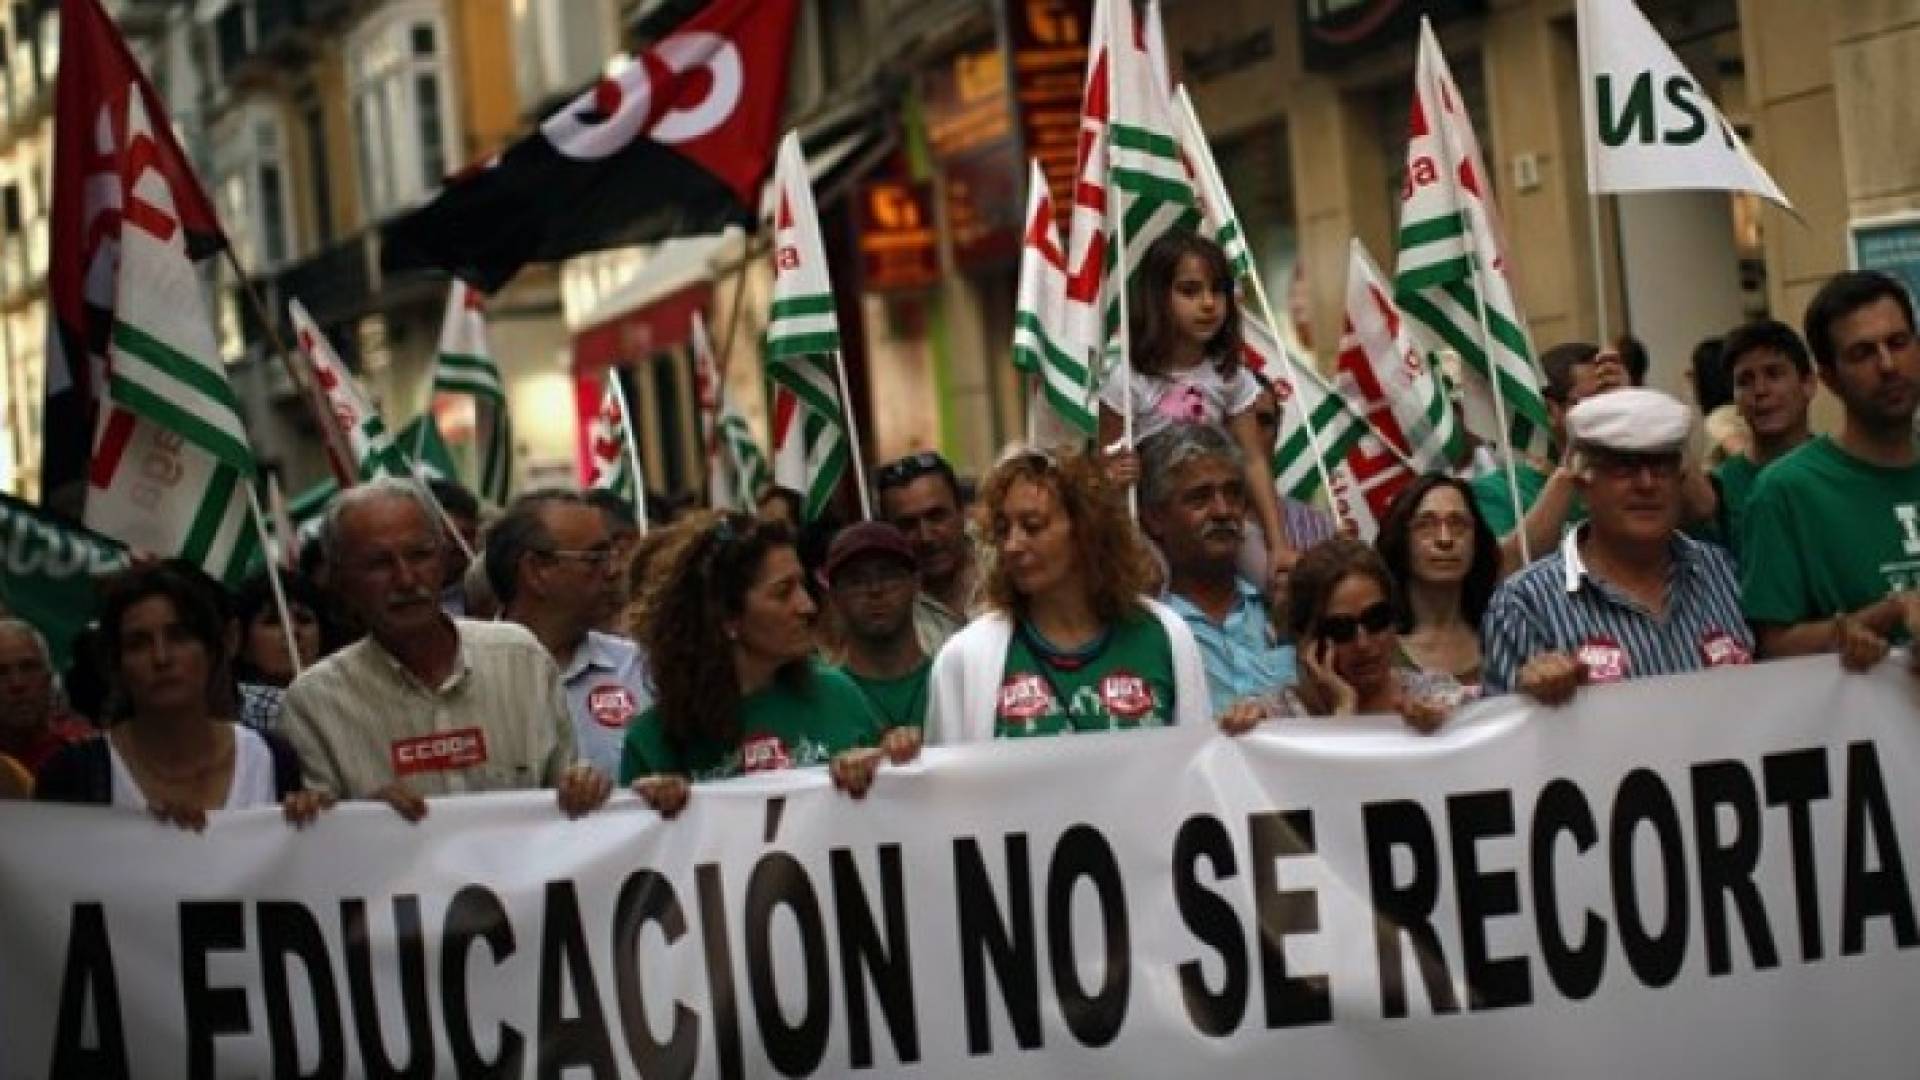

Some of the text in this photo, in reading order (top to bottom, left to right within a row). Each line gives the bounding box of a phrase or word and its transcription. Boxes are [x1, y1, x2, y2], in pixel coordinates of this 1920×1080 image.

[50, 740, 1920, 1080] A EDUCACIÓN NO SE RECORTA
